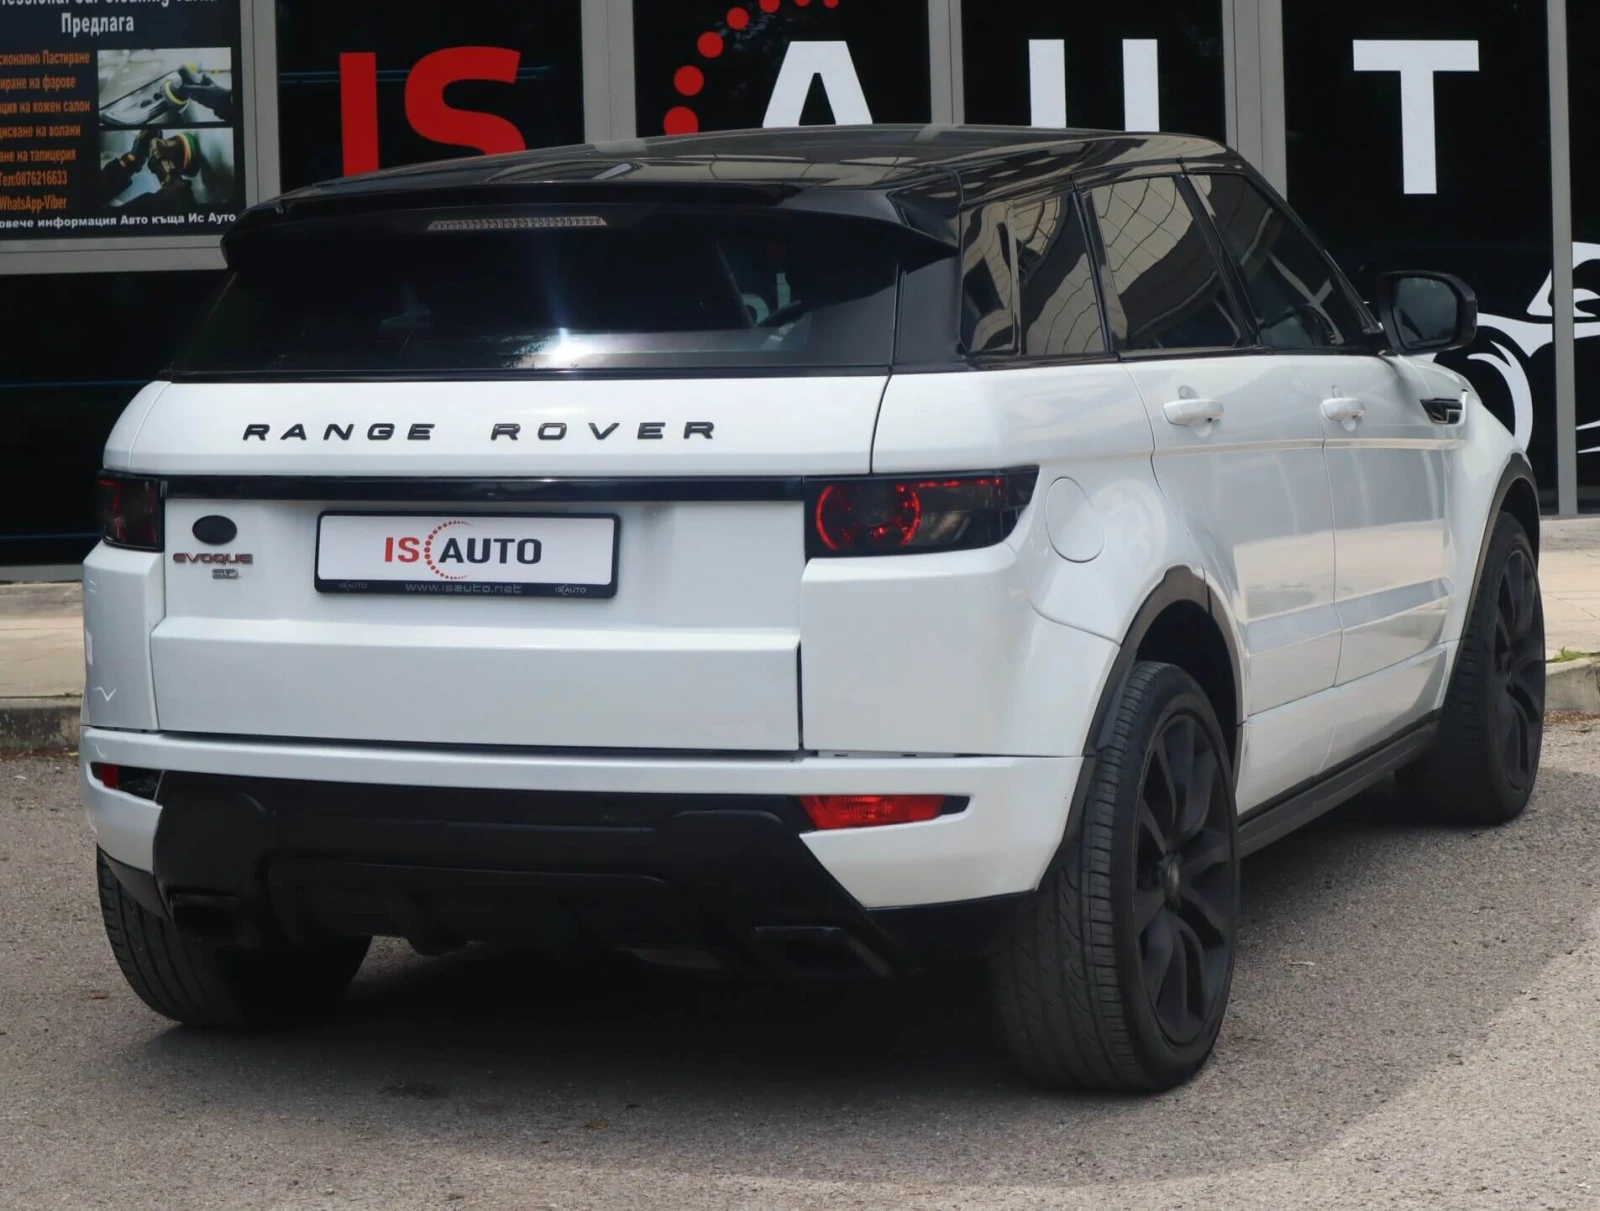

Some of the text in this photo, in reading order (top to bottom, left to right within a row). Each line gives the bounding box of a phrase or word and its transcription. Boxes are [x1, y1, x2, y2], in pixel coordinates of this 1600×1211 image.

[61, 12, 135, 38] Предлага
[29, 77, 40, 90] на
[42, 73, 76, 93] фарове
[20, 102, 31, 114] на
[33, 101, 61, 113] кожен
[63, 100, 90, 112] салон
[340, 46, 527, 177] IS
[36, 126, 47, 137] на
[49, 125, 81, 137] волани
[17, 150, 28, 162] на
[30, 149, 76, 165] тапицерия
[37, 216, 117, 229] информация
[120, 215, 148, 225] Авто
[151, 214, 185, 225] къща
[188, 213, 204, 223] Ис
[208, 212, 237, 224] Ауто
[241, 421, 716, 442] RANGE ROVER
[172, 552, 254, 566] EVOQUE
[384, 536, 543, 565] IS AUTO
[405, 583, 523, 594] www.isauto.net
